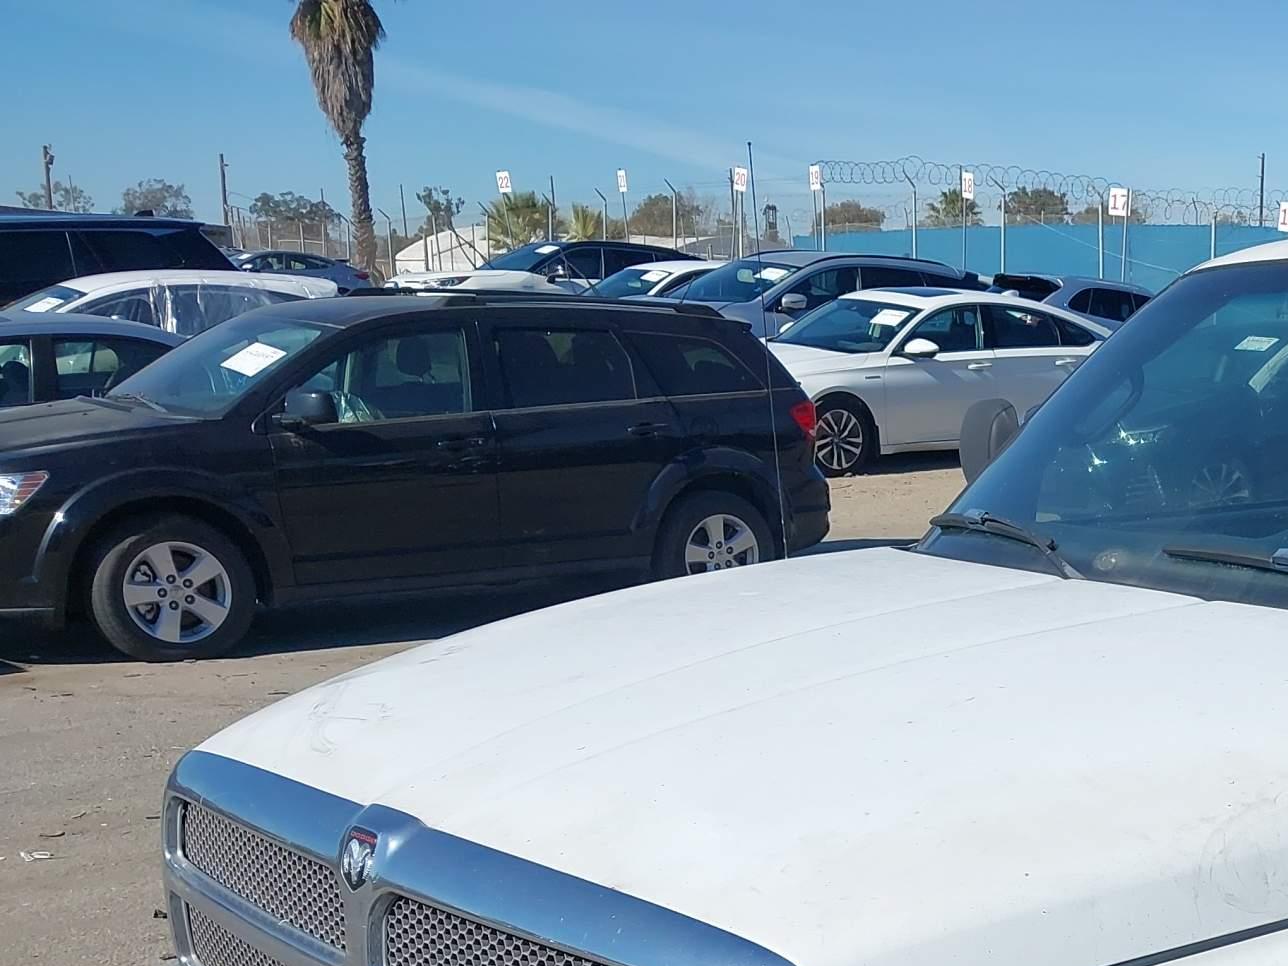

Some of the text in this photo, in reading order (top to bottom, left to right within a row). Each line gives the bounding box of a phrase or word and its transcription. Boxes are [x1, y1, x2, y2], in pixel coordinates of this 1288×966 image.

[498, 175, 510, 189] 22
[735, 172, 746, 187] 20
[810, 170, 819, 185] 19
[963, 178, 973, 194] 18
[1111, 194, 1128, 211] 17
